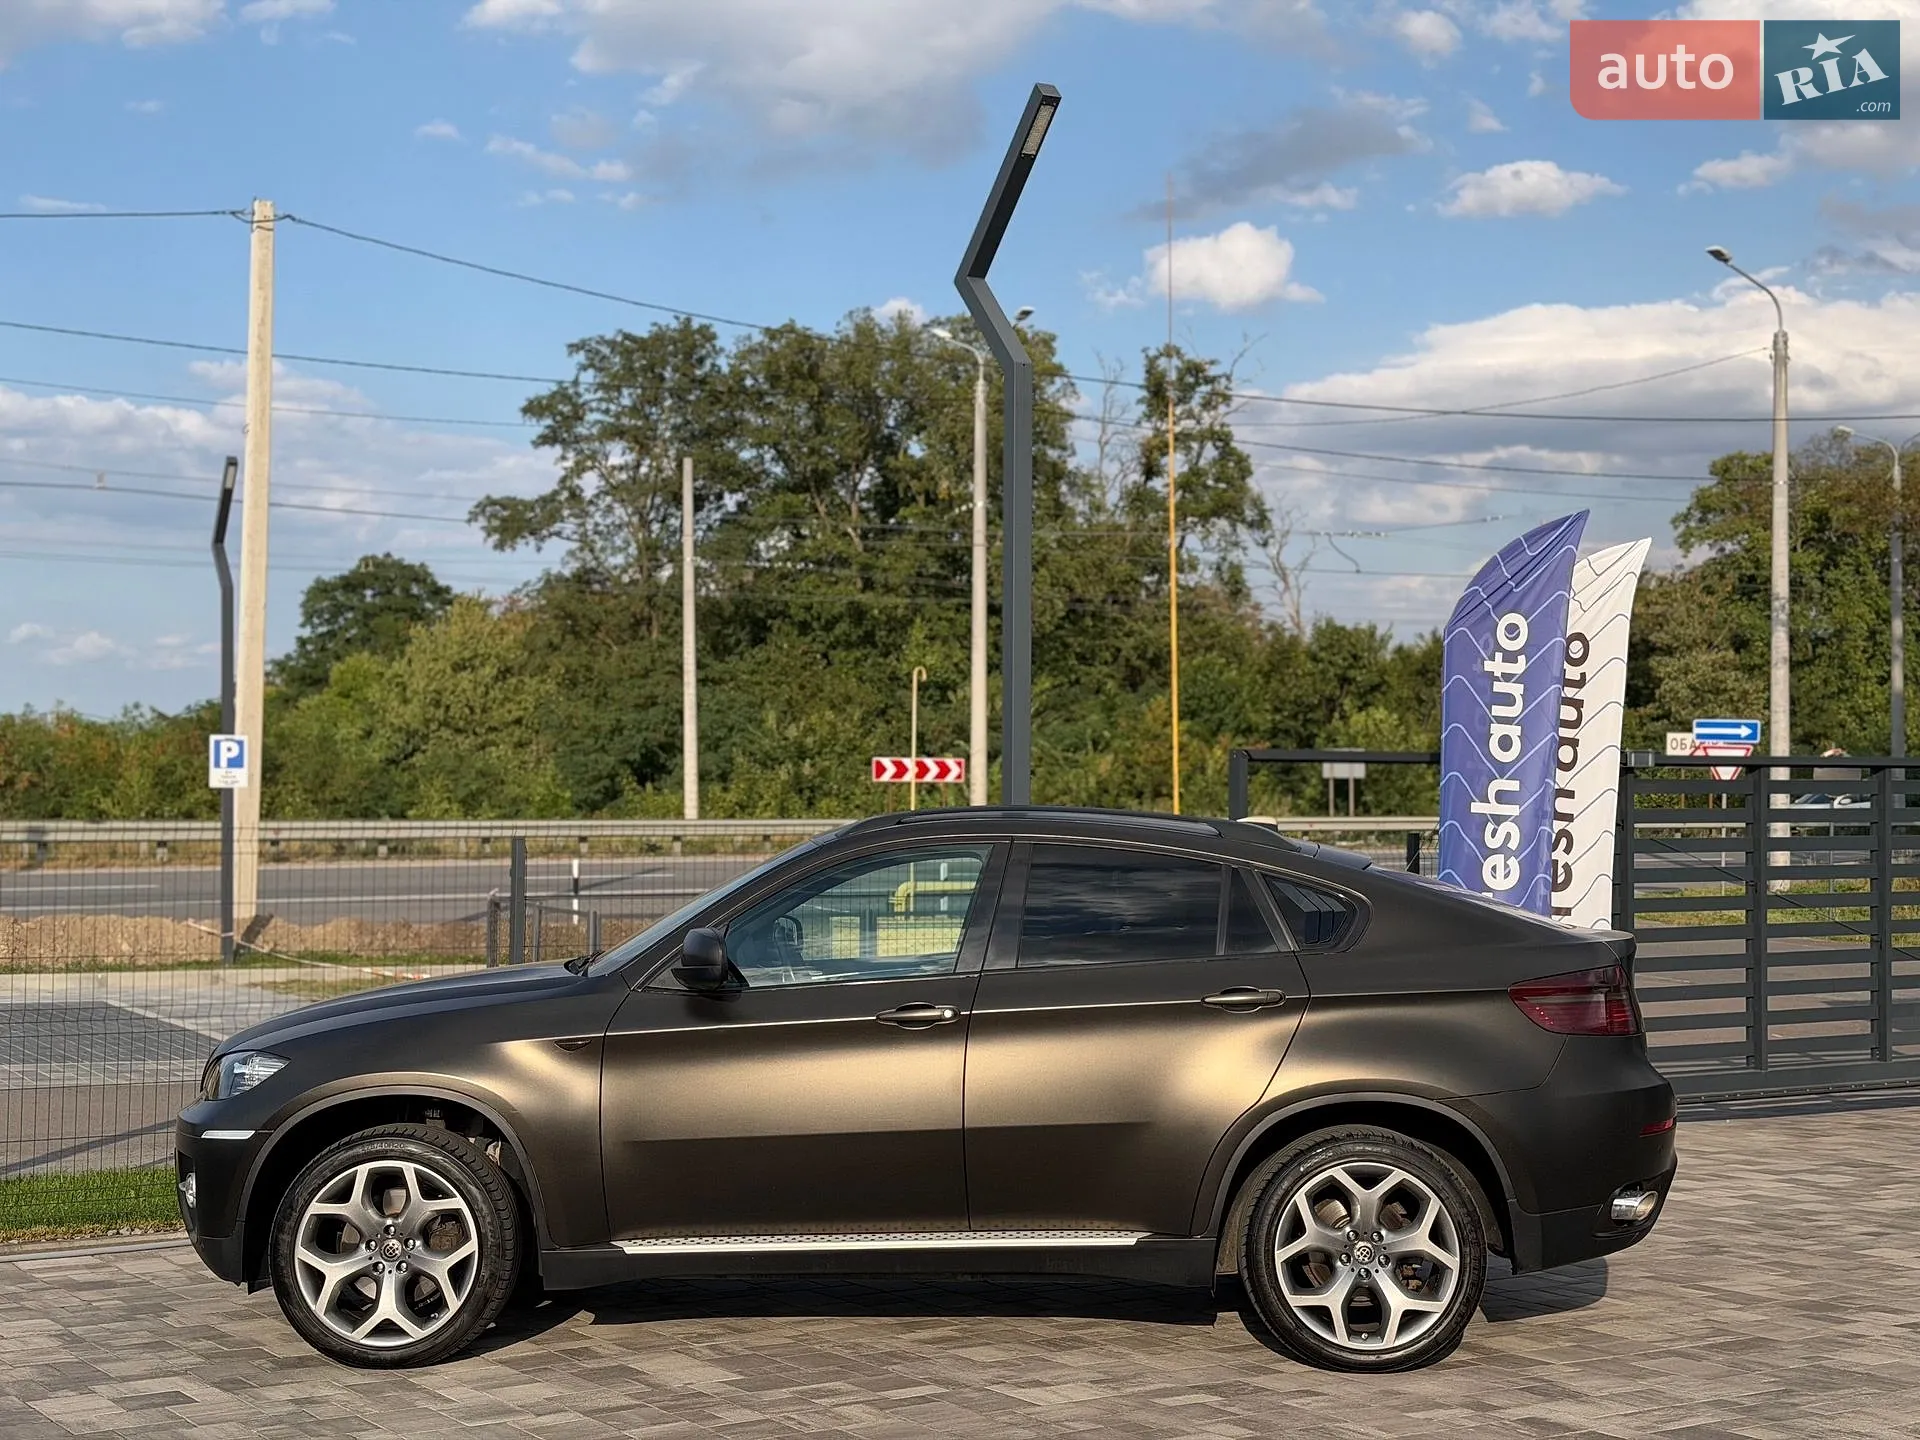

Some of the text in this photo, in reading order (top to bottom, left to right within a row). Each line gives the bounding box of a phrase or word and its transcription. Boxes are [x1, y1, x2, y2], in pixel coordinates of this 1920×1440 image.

[220, 740, 240, 768] P
[1471, 613, 1528, 898] esh auto
[1557, 632, 1590, 772] auto
